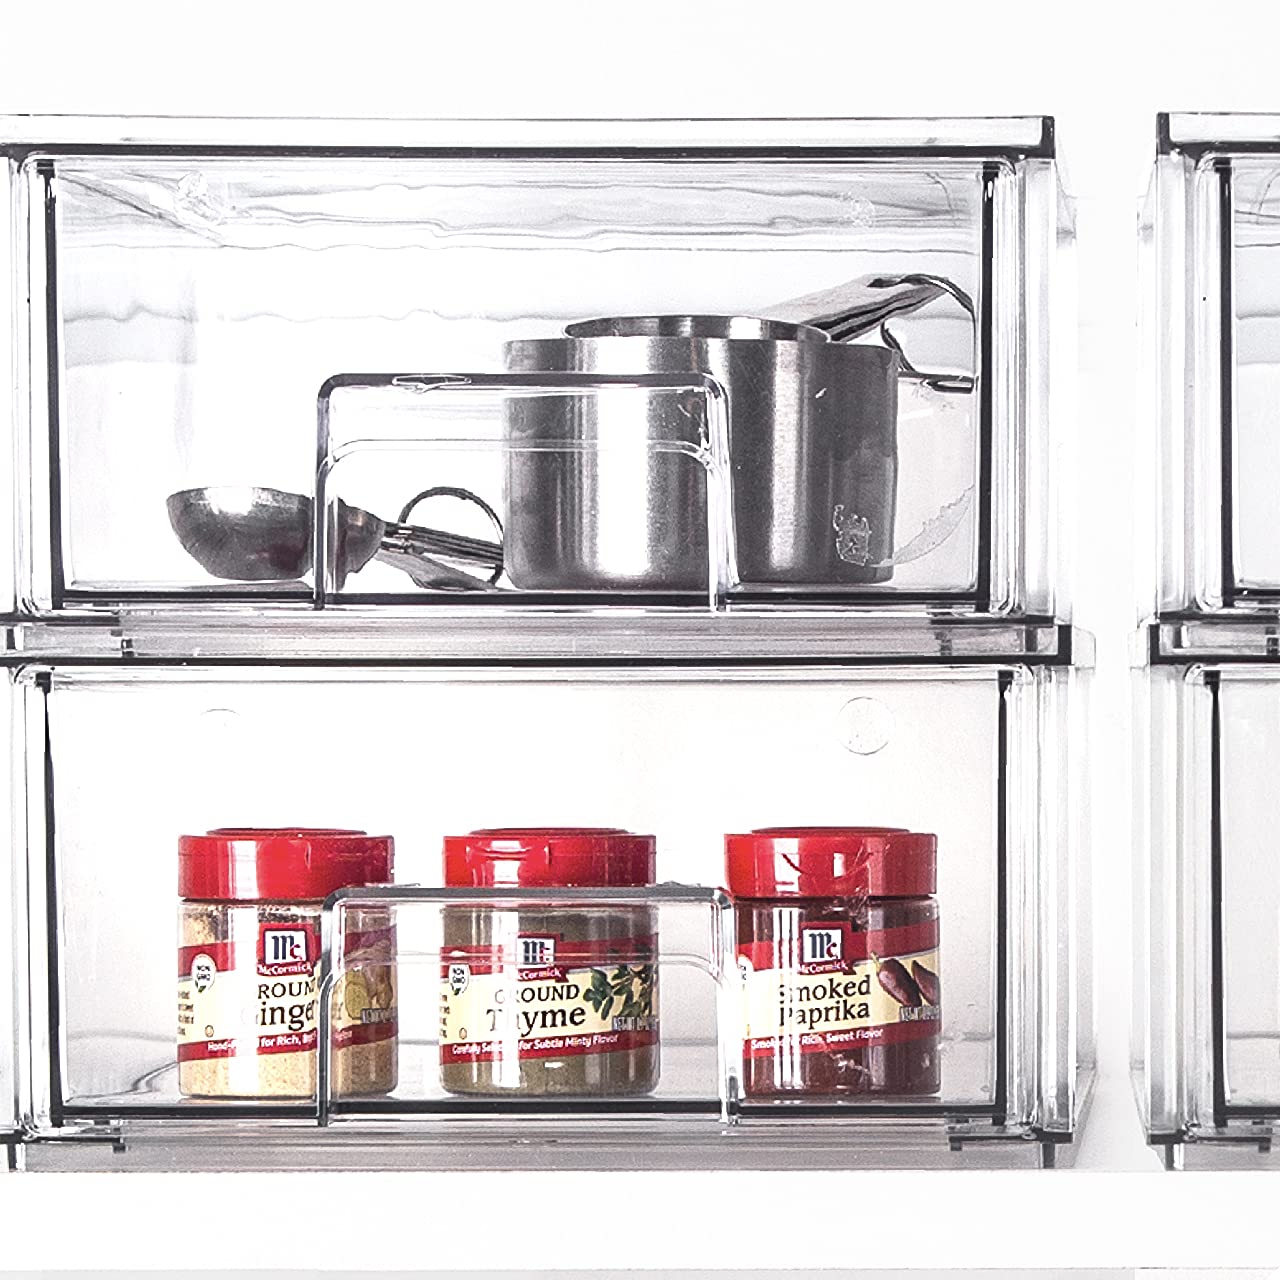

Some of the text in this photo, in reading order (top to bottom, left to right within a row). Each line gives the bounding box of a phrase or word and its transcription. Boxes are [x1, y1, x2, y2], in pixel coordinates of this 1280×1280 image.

[517, 966, 564, 981] cCormick
[257, 977, 317, 1000] ROUN
[494, 982, 581, 1005] GOUND
[485, 1005, 587, 1038] Tyme
